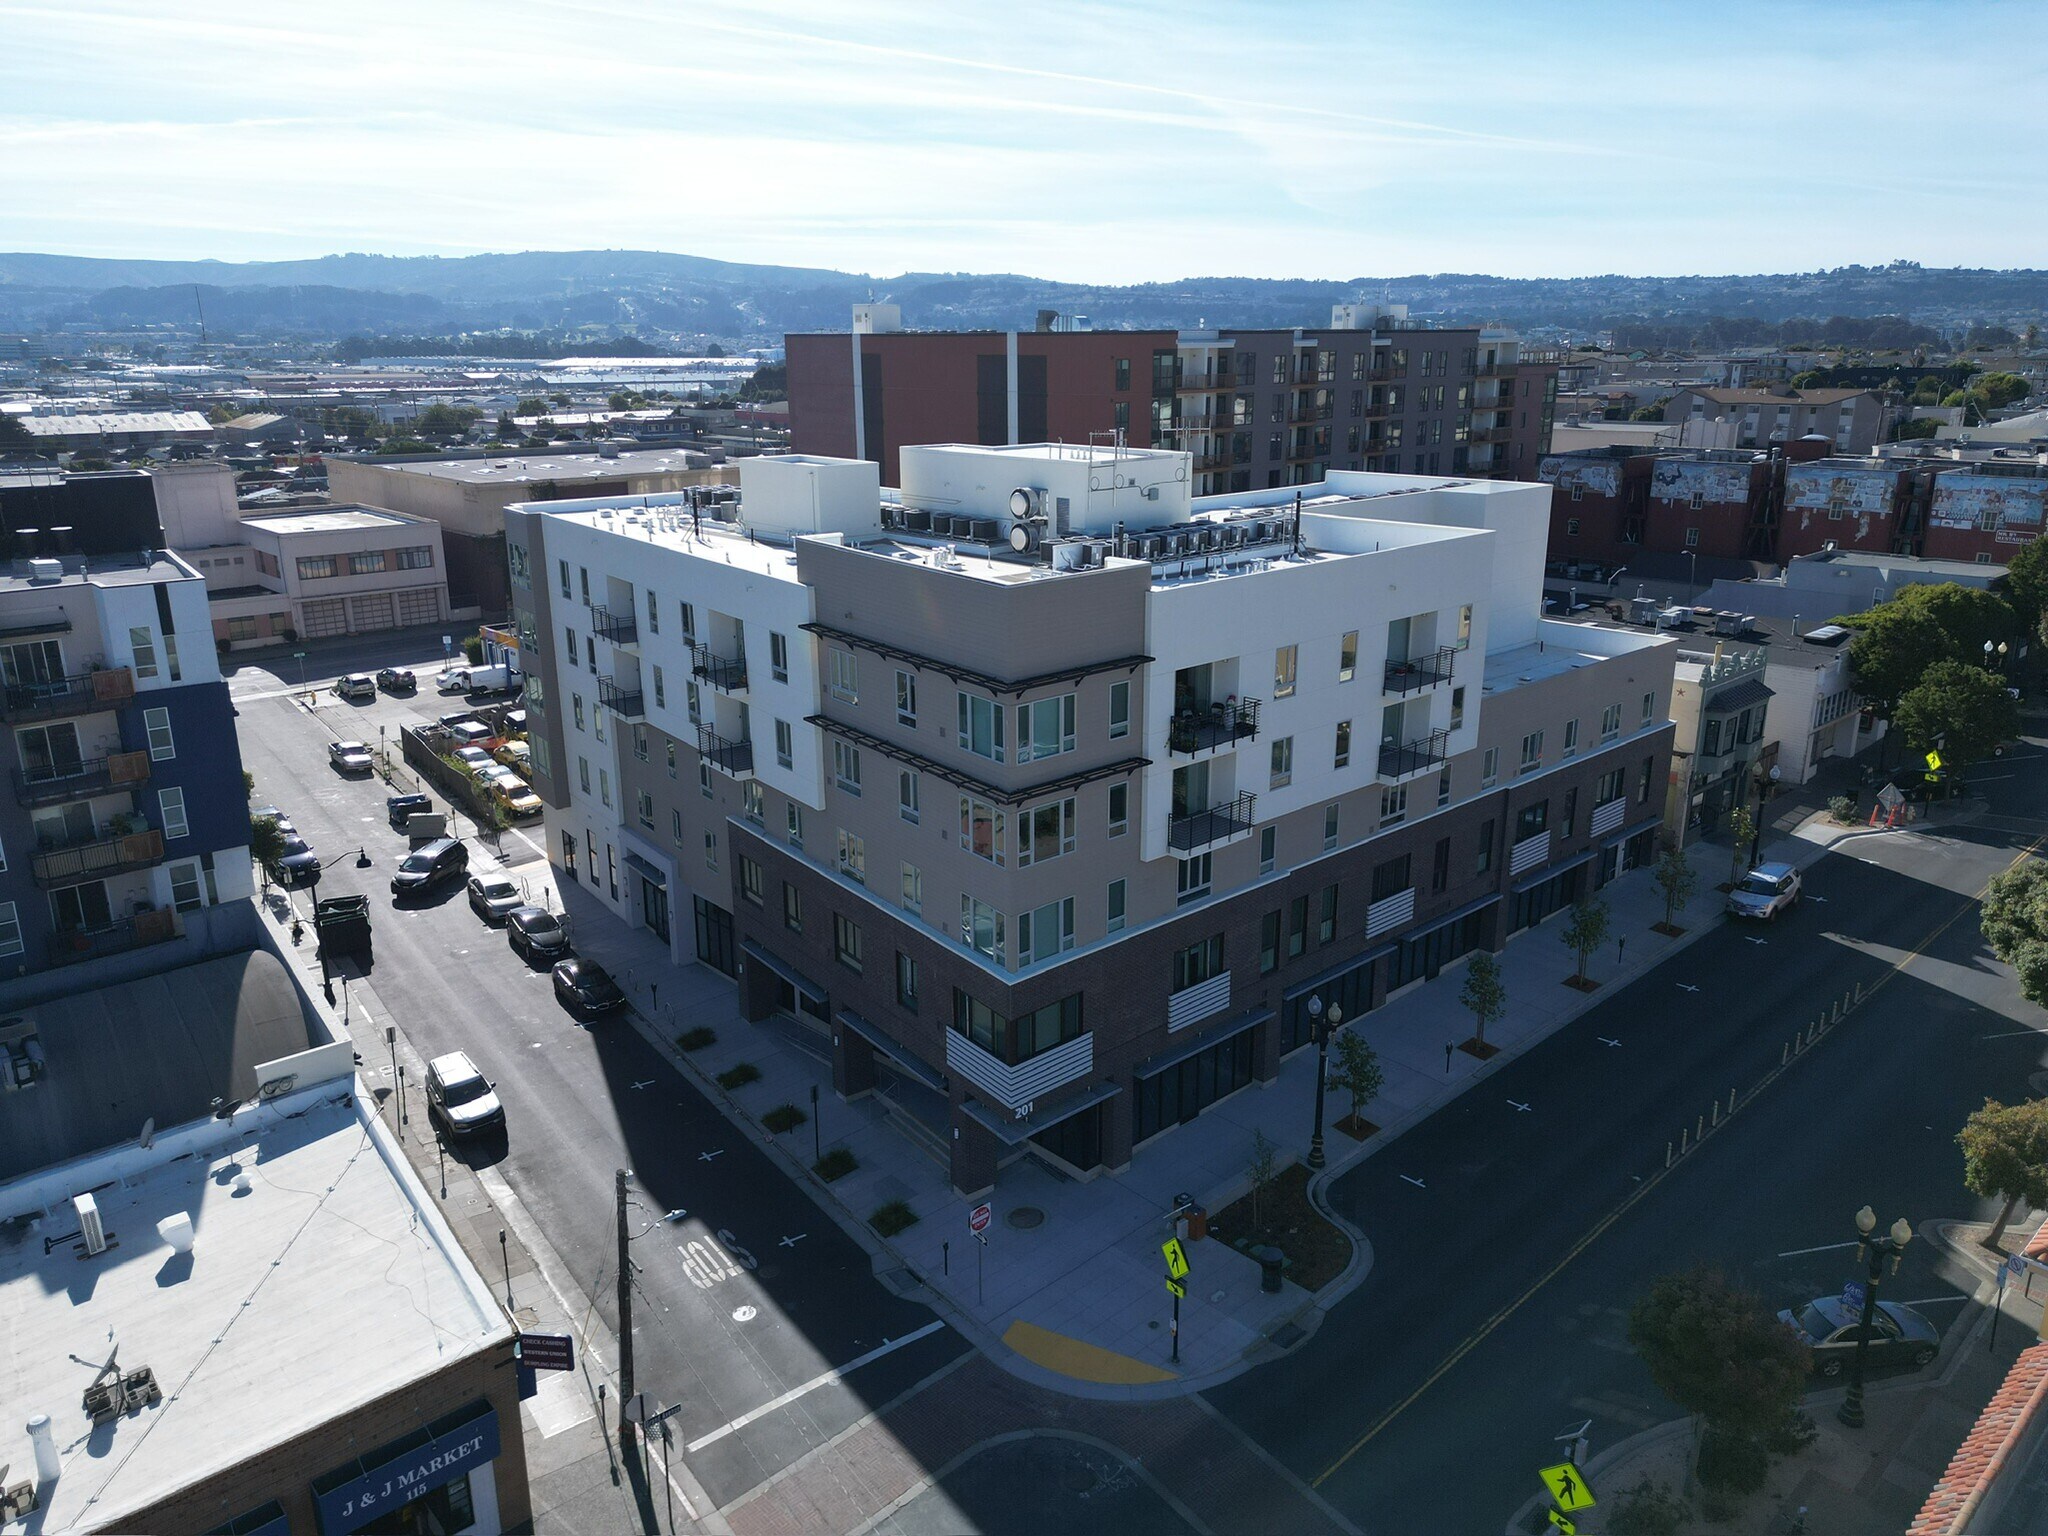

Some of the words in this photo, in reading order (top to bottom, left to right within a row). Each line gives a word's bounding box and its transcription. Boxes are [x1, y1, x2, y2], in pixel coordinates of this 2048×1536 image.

[1015, 1101, 1034, 1119] 201
[677, 1228, 758, 1289] STOP
[342, 1502, 353, 1517] J
[360, 1492, 376, 1508] &
[381, 1480, 393, 1497] J
[397, 1435, 483, 1489] MARKET
[406, 1482, 427, 1501] 115
